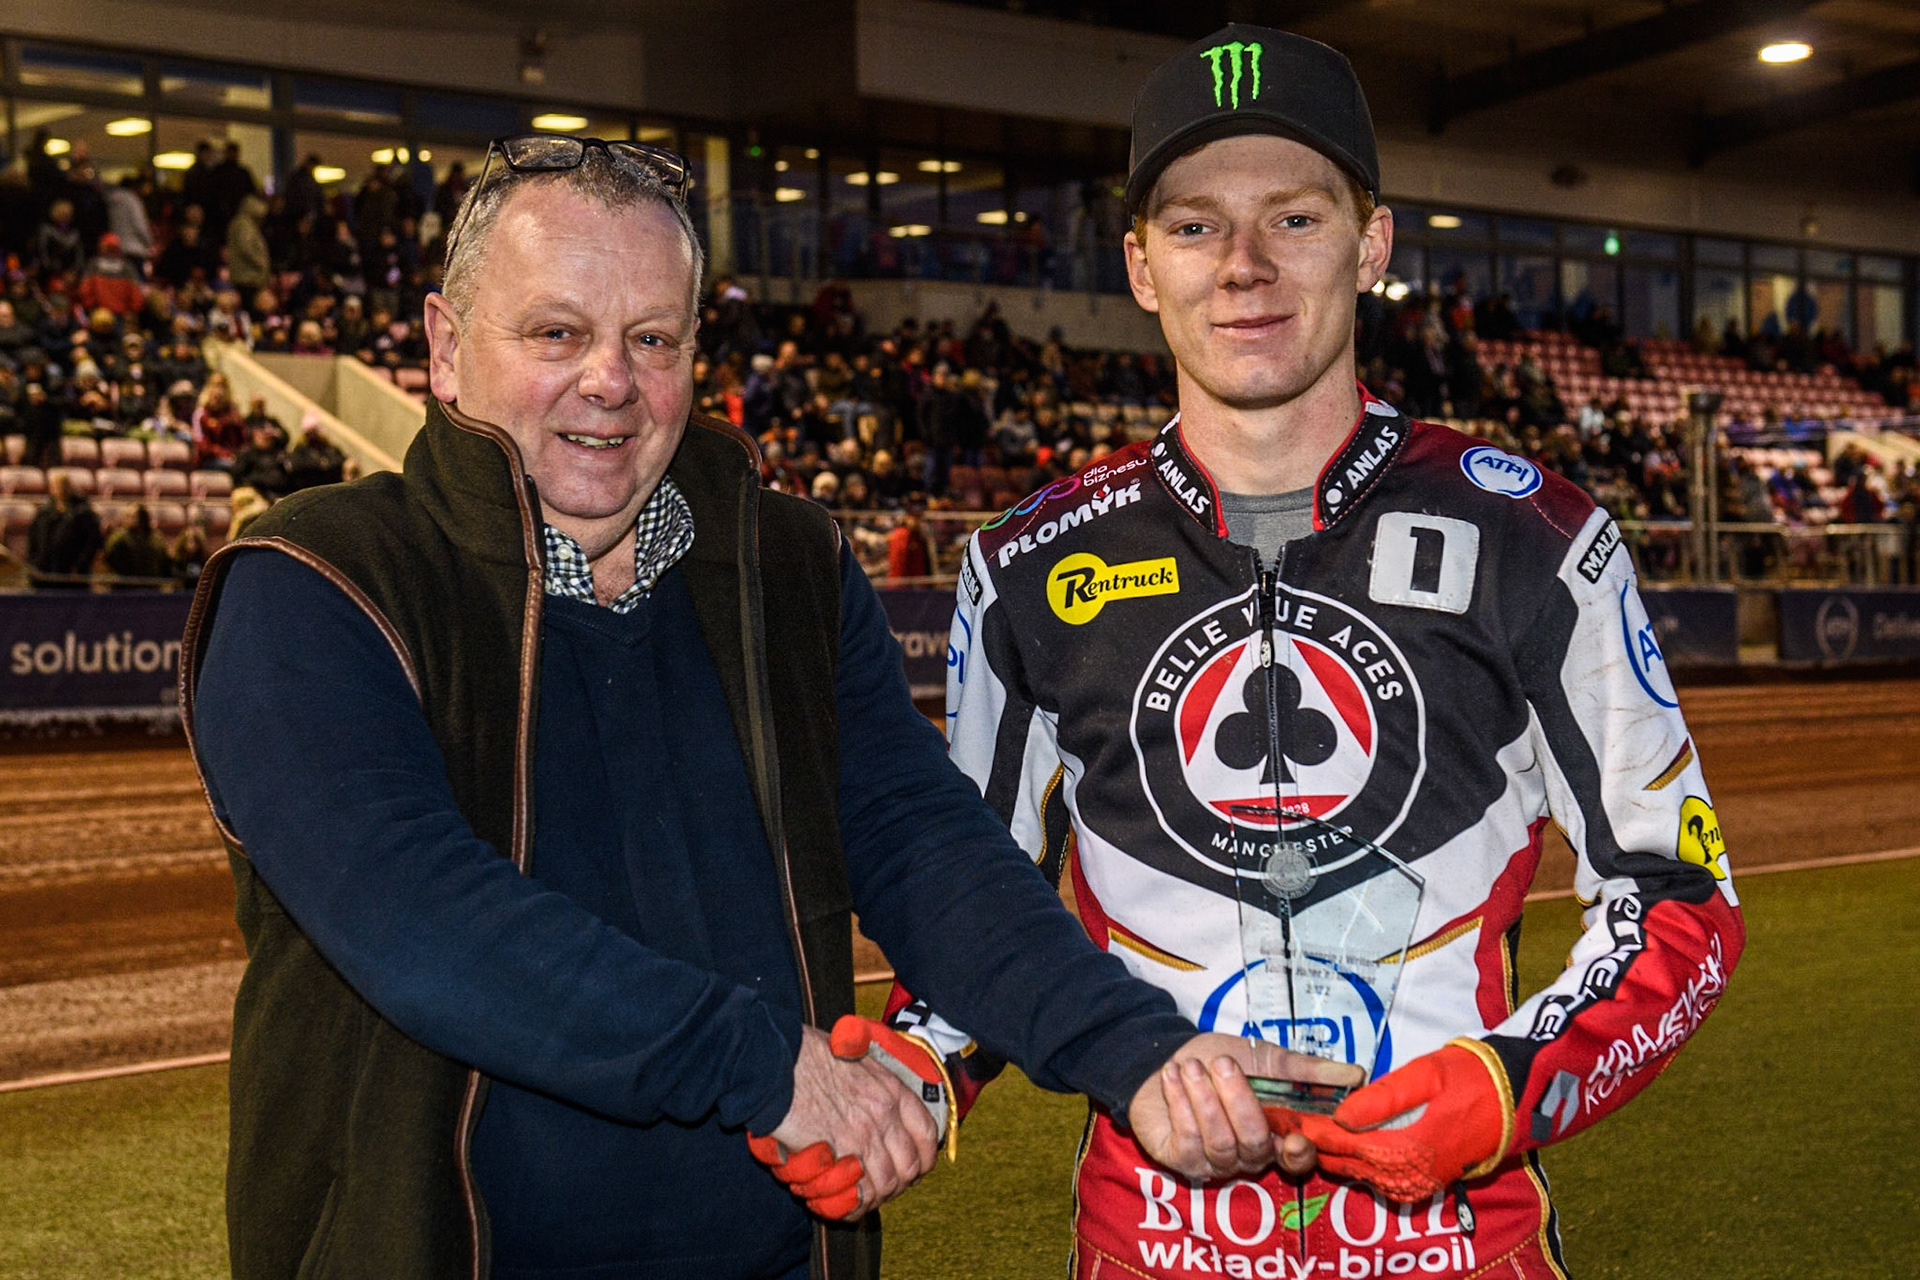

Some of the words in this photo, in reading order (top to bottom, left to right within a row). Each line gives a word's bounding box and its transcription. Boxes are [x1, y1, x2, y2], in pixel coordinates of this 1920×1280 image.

[1083, 465, 1108, 479] dla
[1083, 458, 1148, 487] biznesu
[1345, 425, 1399, 489] ANLAS
[1475, 456, 1529, 482] ATPI
[1158, 459, 1211, 515] ANLAS
[1056, 566, 1174, 609] Rentruck
[1145, 619, 1228, 712] BELLE
[1329, 625, 1404, 701] ACES
[1211, 826, 1353, 858] MANCESTER
[1134, 1167, 1276, 1247] BIO
